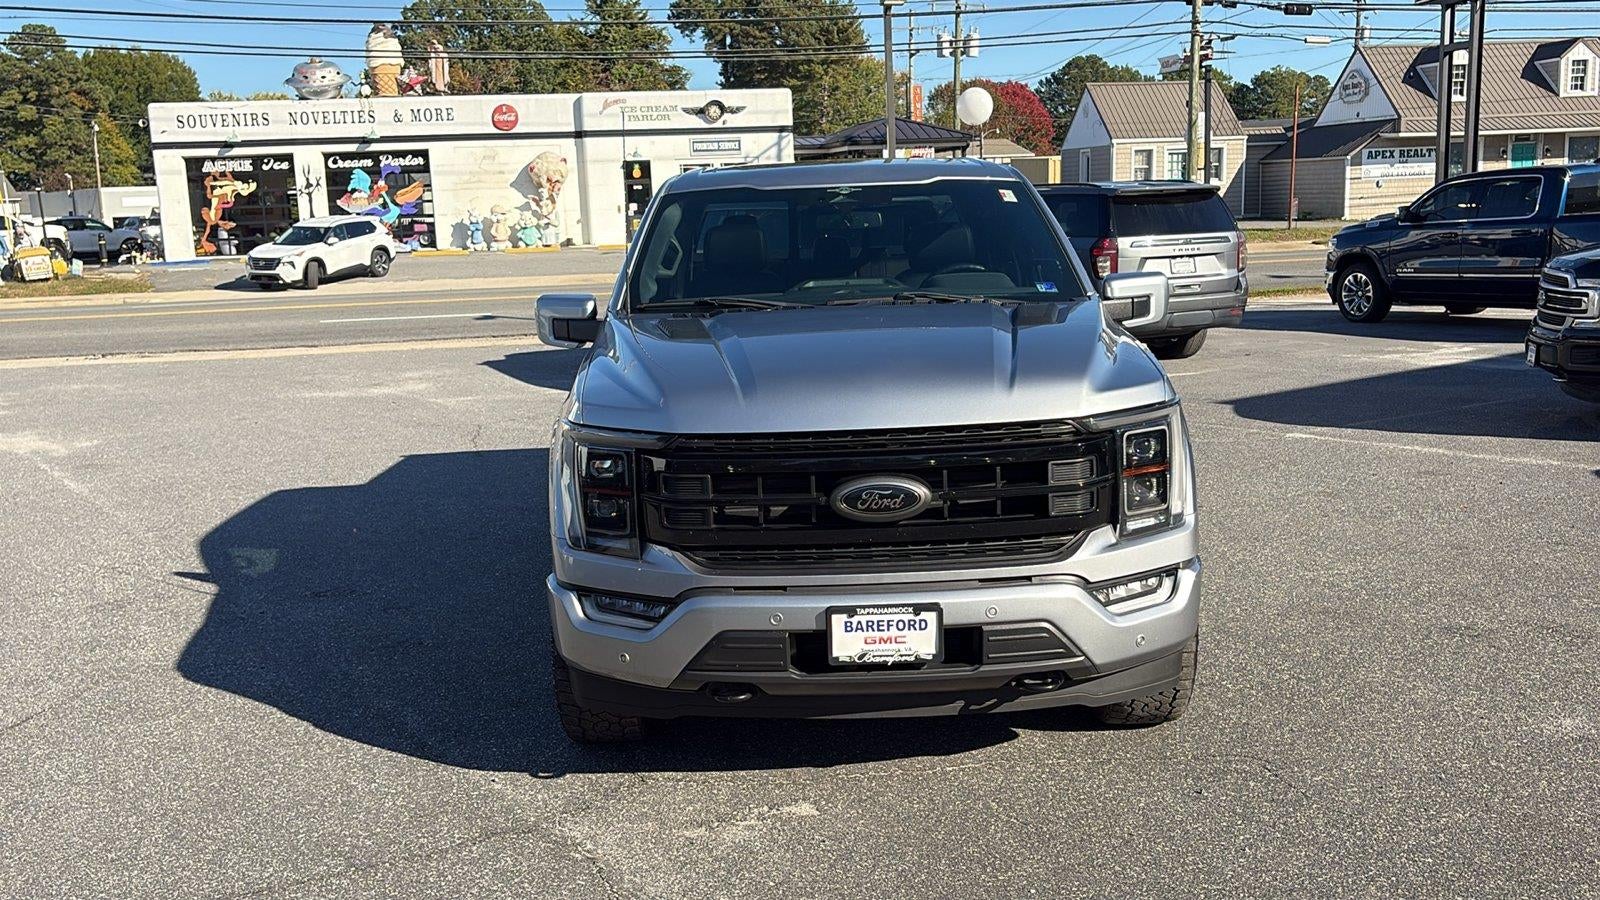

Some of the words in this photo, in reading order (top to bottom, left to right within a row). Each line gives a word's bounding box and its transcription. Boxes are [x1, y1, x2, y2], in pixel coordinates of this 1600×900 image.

[620, 106, 637, 114] ICE
[639, 105, 678, 114] CREAM
[176, 112, 270, 129] SOUVENIRS
[288, 109, 376, 126] NOVELTIES
[392, 109, 404, 123] &
[410, 107, 455, 122] MORE
[627, 114, 671, 122] PARLOR
[327, 156, 373, 169] Cream
[379, 154, 426, 167] Parlor
[1367, 149, 1396, 160] APEX
[201, 159, 253, 173] ACME
[261, 157, 292, 171] Ice
[857, 489, 905, 510] Ford
[856, 606, 914, 615] TAPPAHANNOCK
[844, 618, 928, 633] BAREFORD
[864, 635, 907, 645] GMC
[854, 650, 919, 666] Bareford
